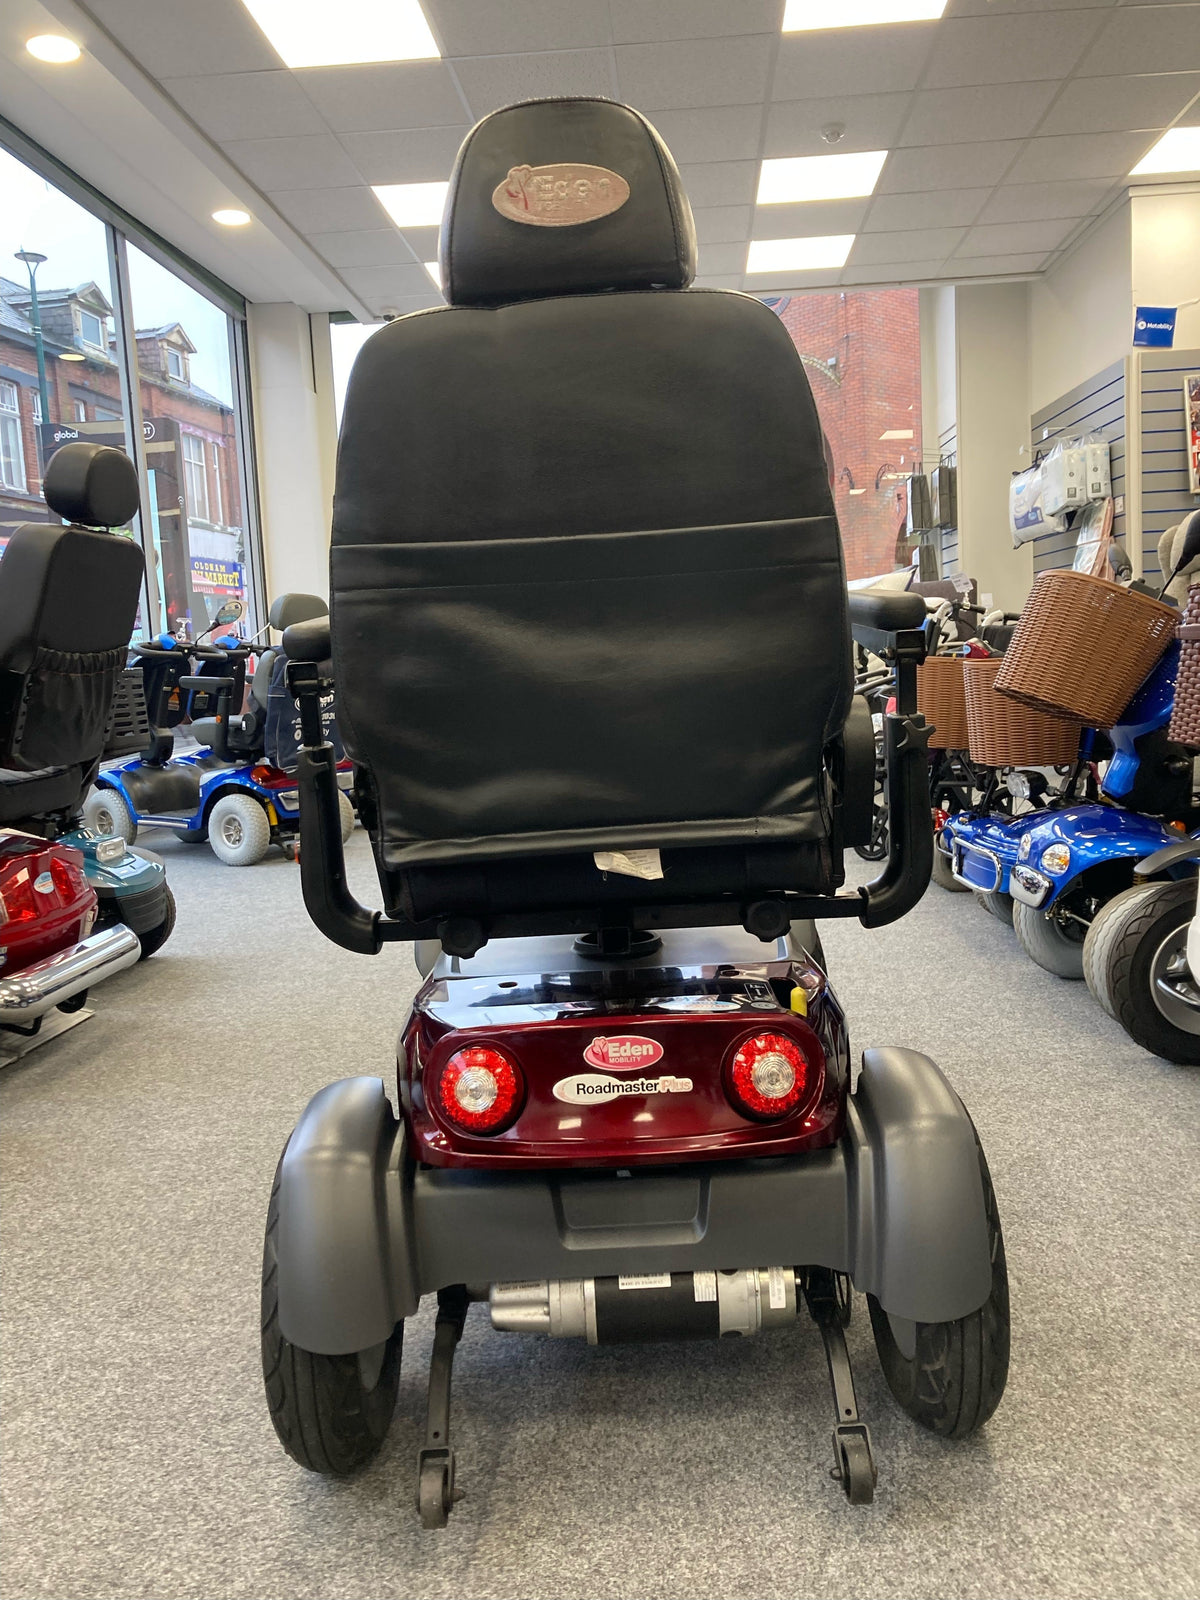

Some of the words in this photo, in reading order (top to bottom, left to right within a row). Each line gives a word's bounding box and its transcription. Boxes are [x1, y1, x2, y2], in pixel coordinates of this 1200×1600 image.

[1147, 322, 1173, 331] Motability
[54, 431, 78, 441] global
[194, 561, 226, 572] OLDHAM
[204, 571, 240, 587] MARKET
[608, 1042, 654, 1057] Eden
[576, 1081, 660, 1095] Roadmaster
[661, 1079, 692, 1091] Plus
